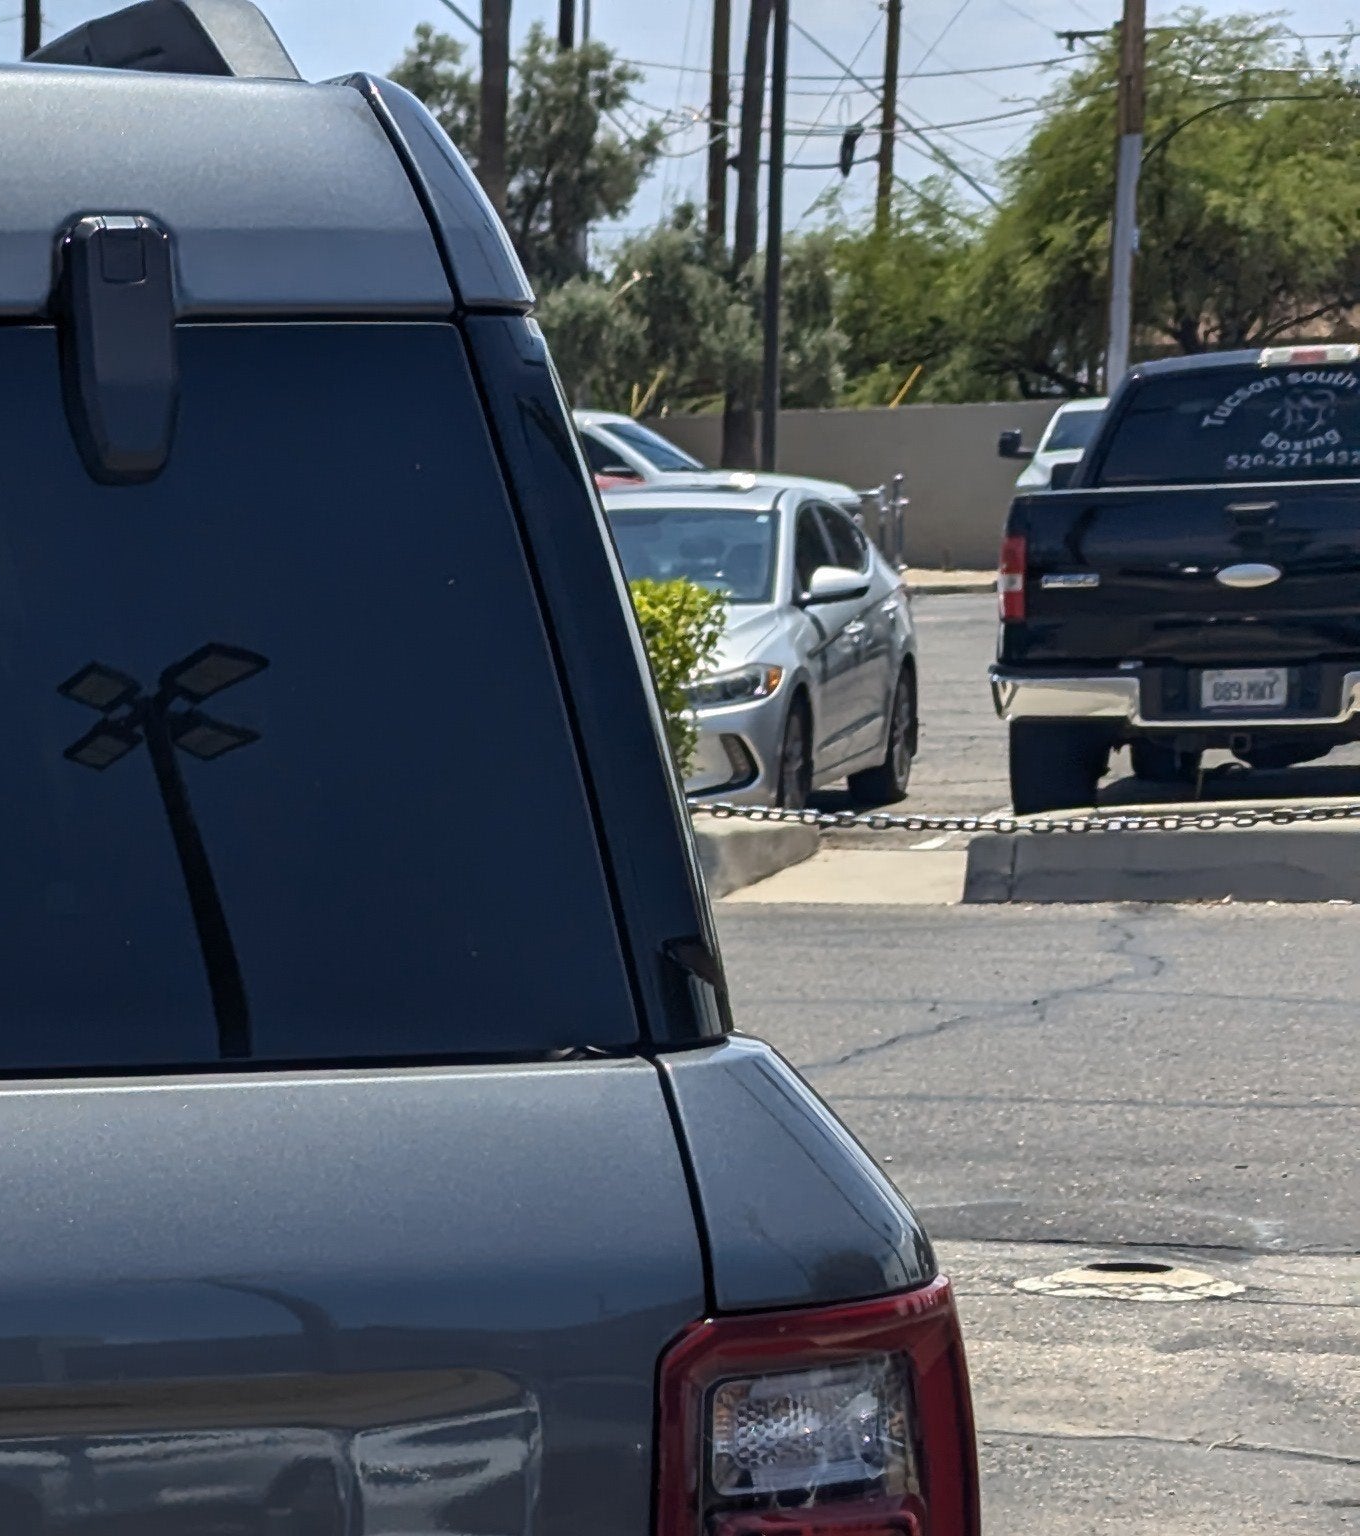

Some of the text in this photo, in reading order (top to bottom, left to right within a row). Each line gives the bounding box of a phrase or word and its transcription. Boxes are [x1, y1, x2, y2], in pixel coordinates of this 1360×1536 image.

[1201, 370, 1358, 427] Tucson south
[1260, 429, 1341, 451] Boxing
